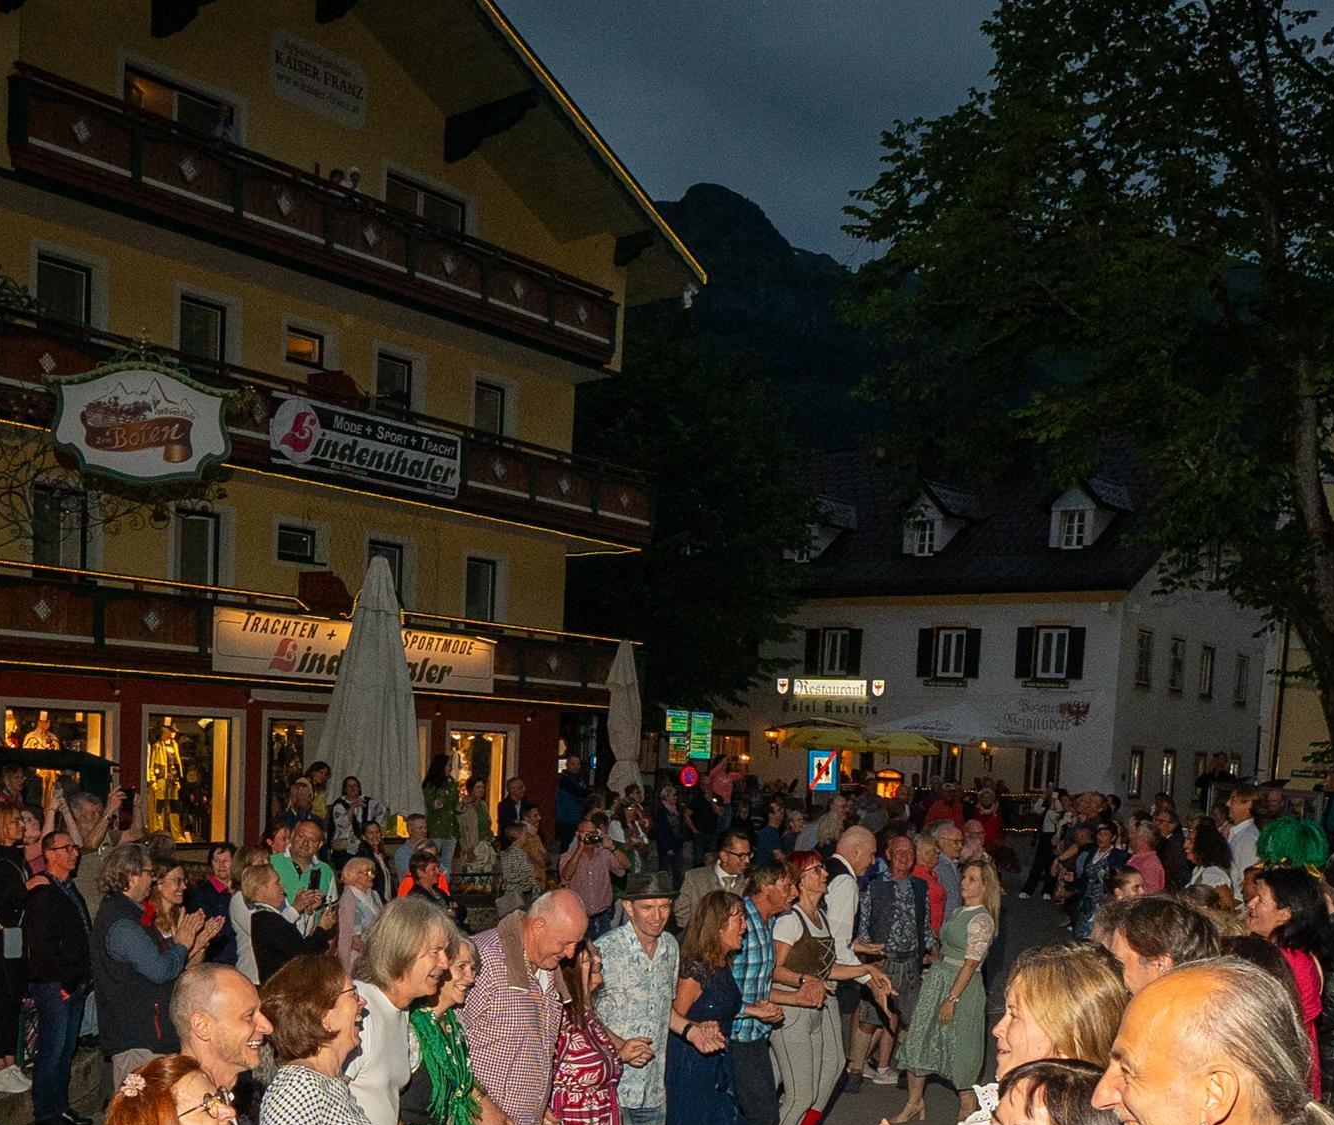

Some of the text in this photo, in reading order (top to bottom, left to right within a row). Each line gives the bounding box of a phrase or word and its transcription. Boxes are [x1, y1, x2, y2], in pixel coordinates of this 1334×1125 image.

[274, 49, 364, 100] KAISER FRANZ
[333, 415, 363, 435] MODE
[376, 425, 408, 446] SPORT
[421, 436, 457, 457] TRACHT
[241, 612, 319, 639] TRACHTEN
[402, 630, 475, 655] SPORTMODE
[782, 699, 878, 715] Hotel Austria
[794, 680, 865, 695] Restaurant
